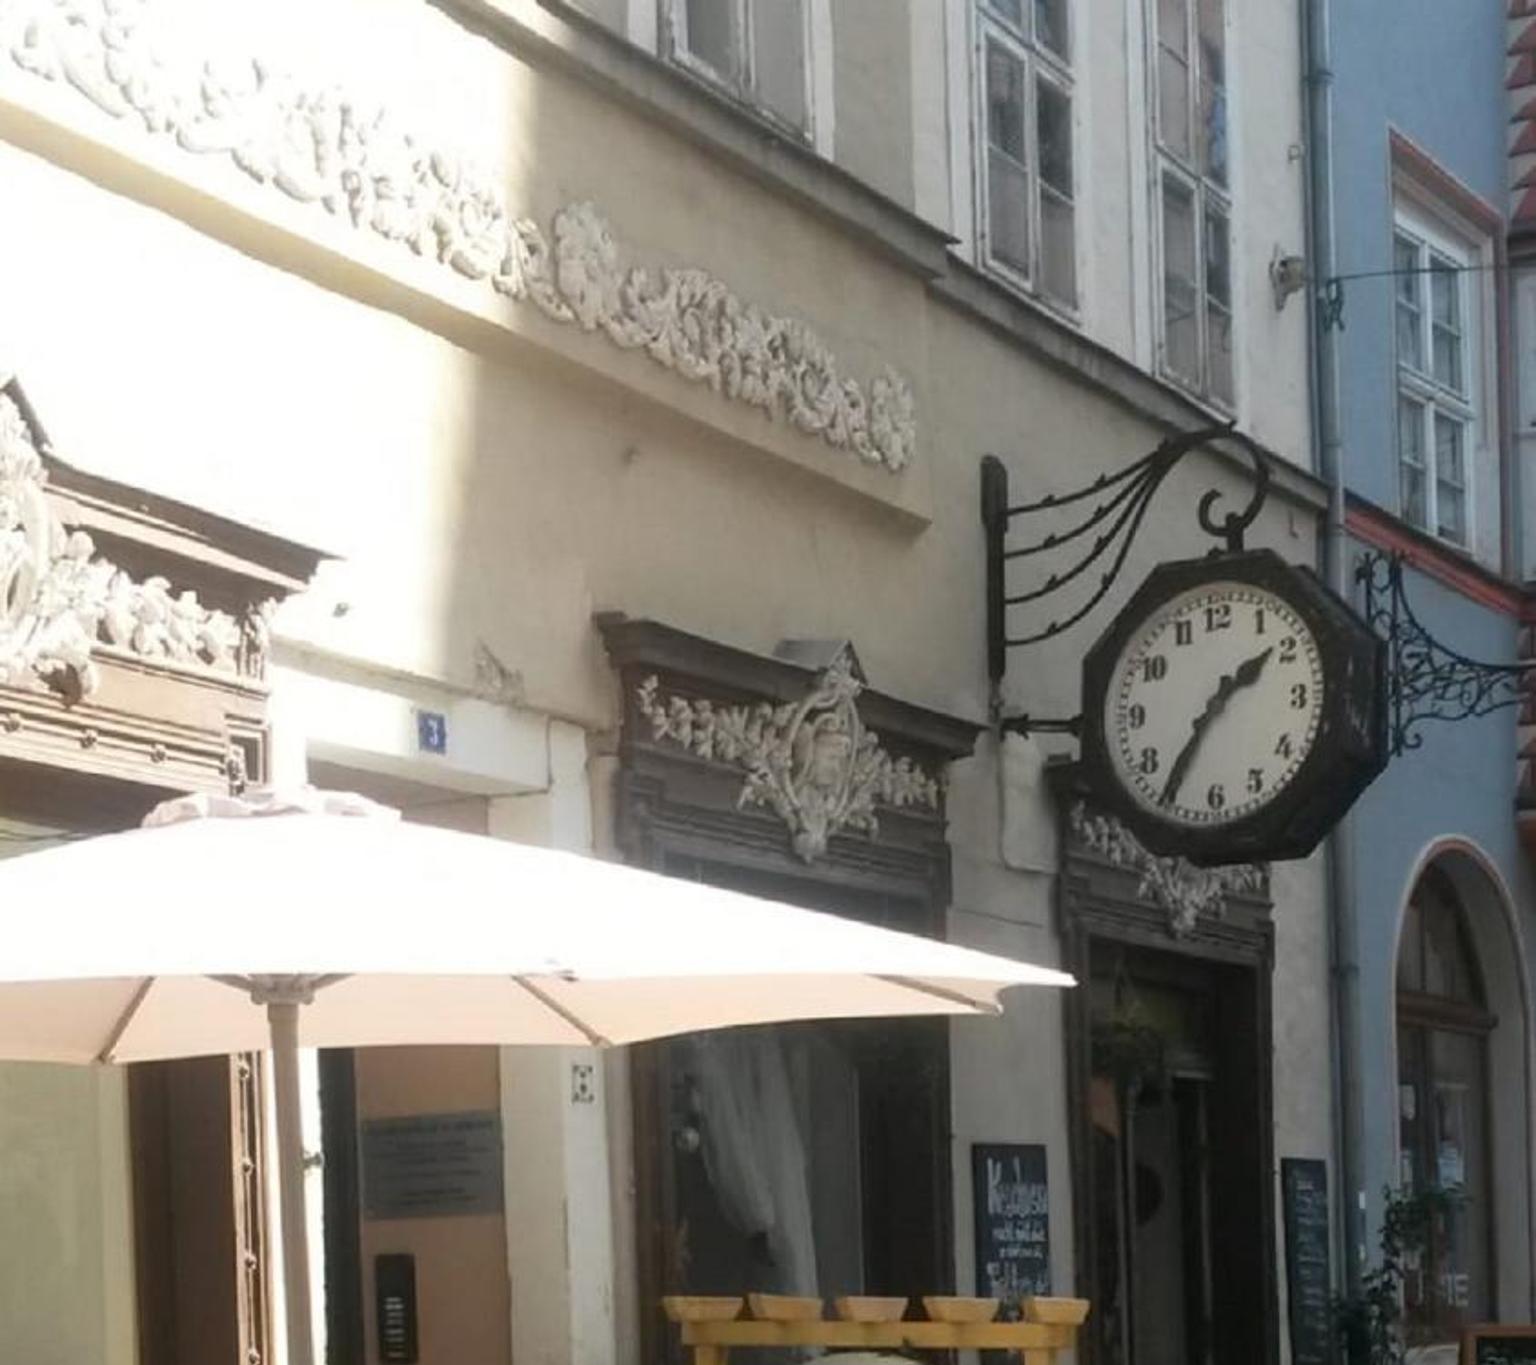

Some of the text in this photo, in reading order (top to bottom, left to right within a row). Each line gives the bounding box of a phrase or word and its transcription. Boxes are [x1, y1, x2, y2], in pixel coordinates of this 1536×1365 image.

[1205, 604, 1231, 632] 12
[1254, 609, 1265, 635] 1
[1175, 620, 1193, 646] 11
[1279, 636, 1297, 664] 2
[1143, 655, 1168, 682] 10
[1291, 683, 1307, 710] 3
[1128, 704, 1146, 729] 9
[1275, 733, 1292, 759] 4
[1140, 748, 1159, 774] 8
[1248, 768, 1264, 794] 5
[1207, 784, 1225, 810] 6
